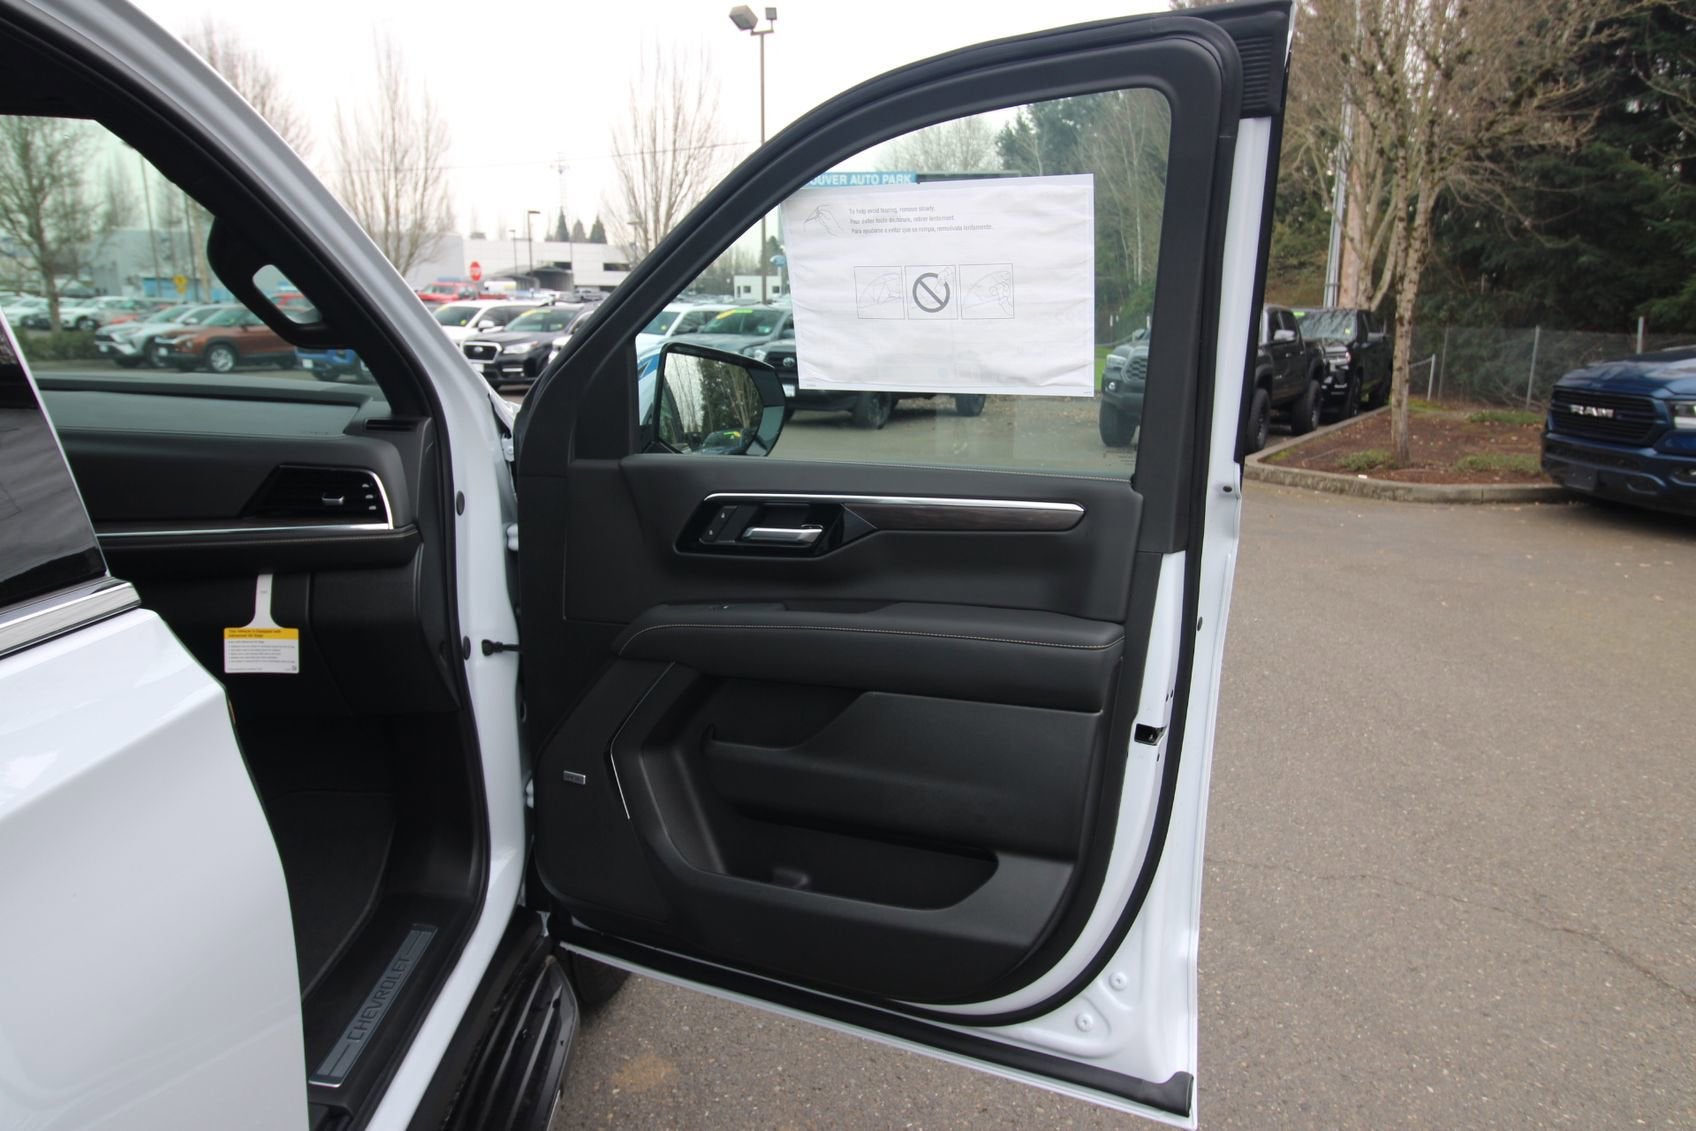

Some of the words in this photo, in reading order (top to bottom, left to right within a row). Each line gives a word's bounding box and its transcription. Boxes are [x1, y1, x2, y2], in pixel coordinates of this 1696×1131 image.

[850, 174, 880, 185] AUTO
[882, 173, 912, 185] PARK
[1570, 404, 1614, 418] RAM
[347, 957, 410, 1041] CHEVROLET
